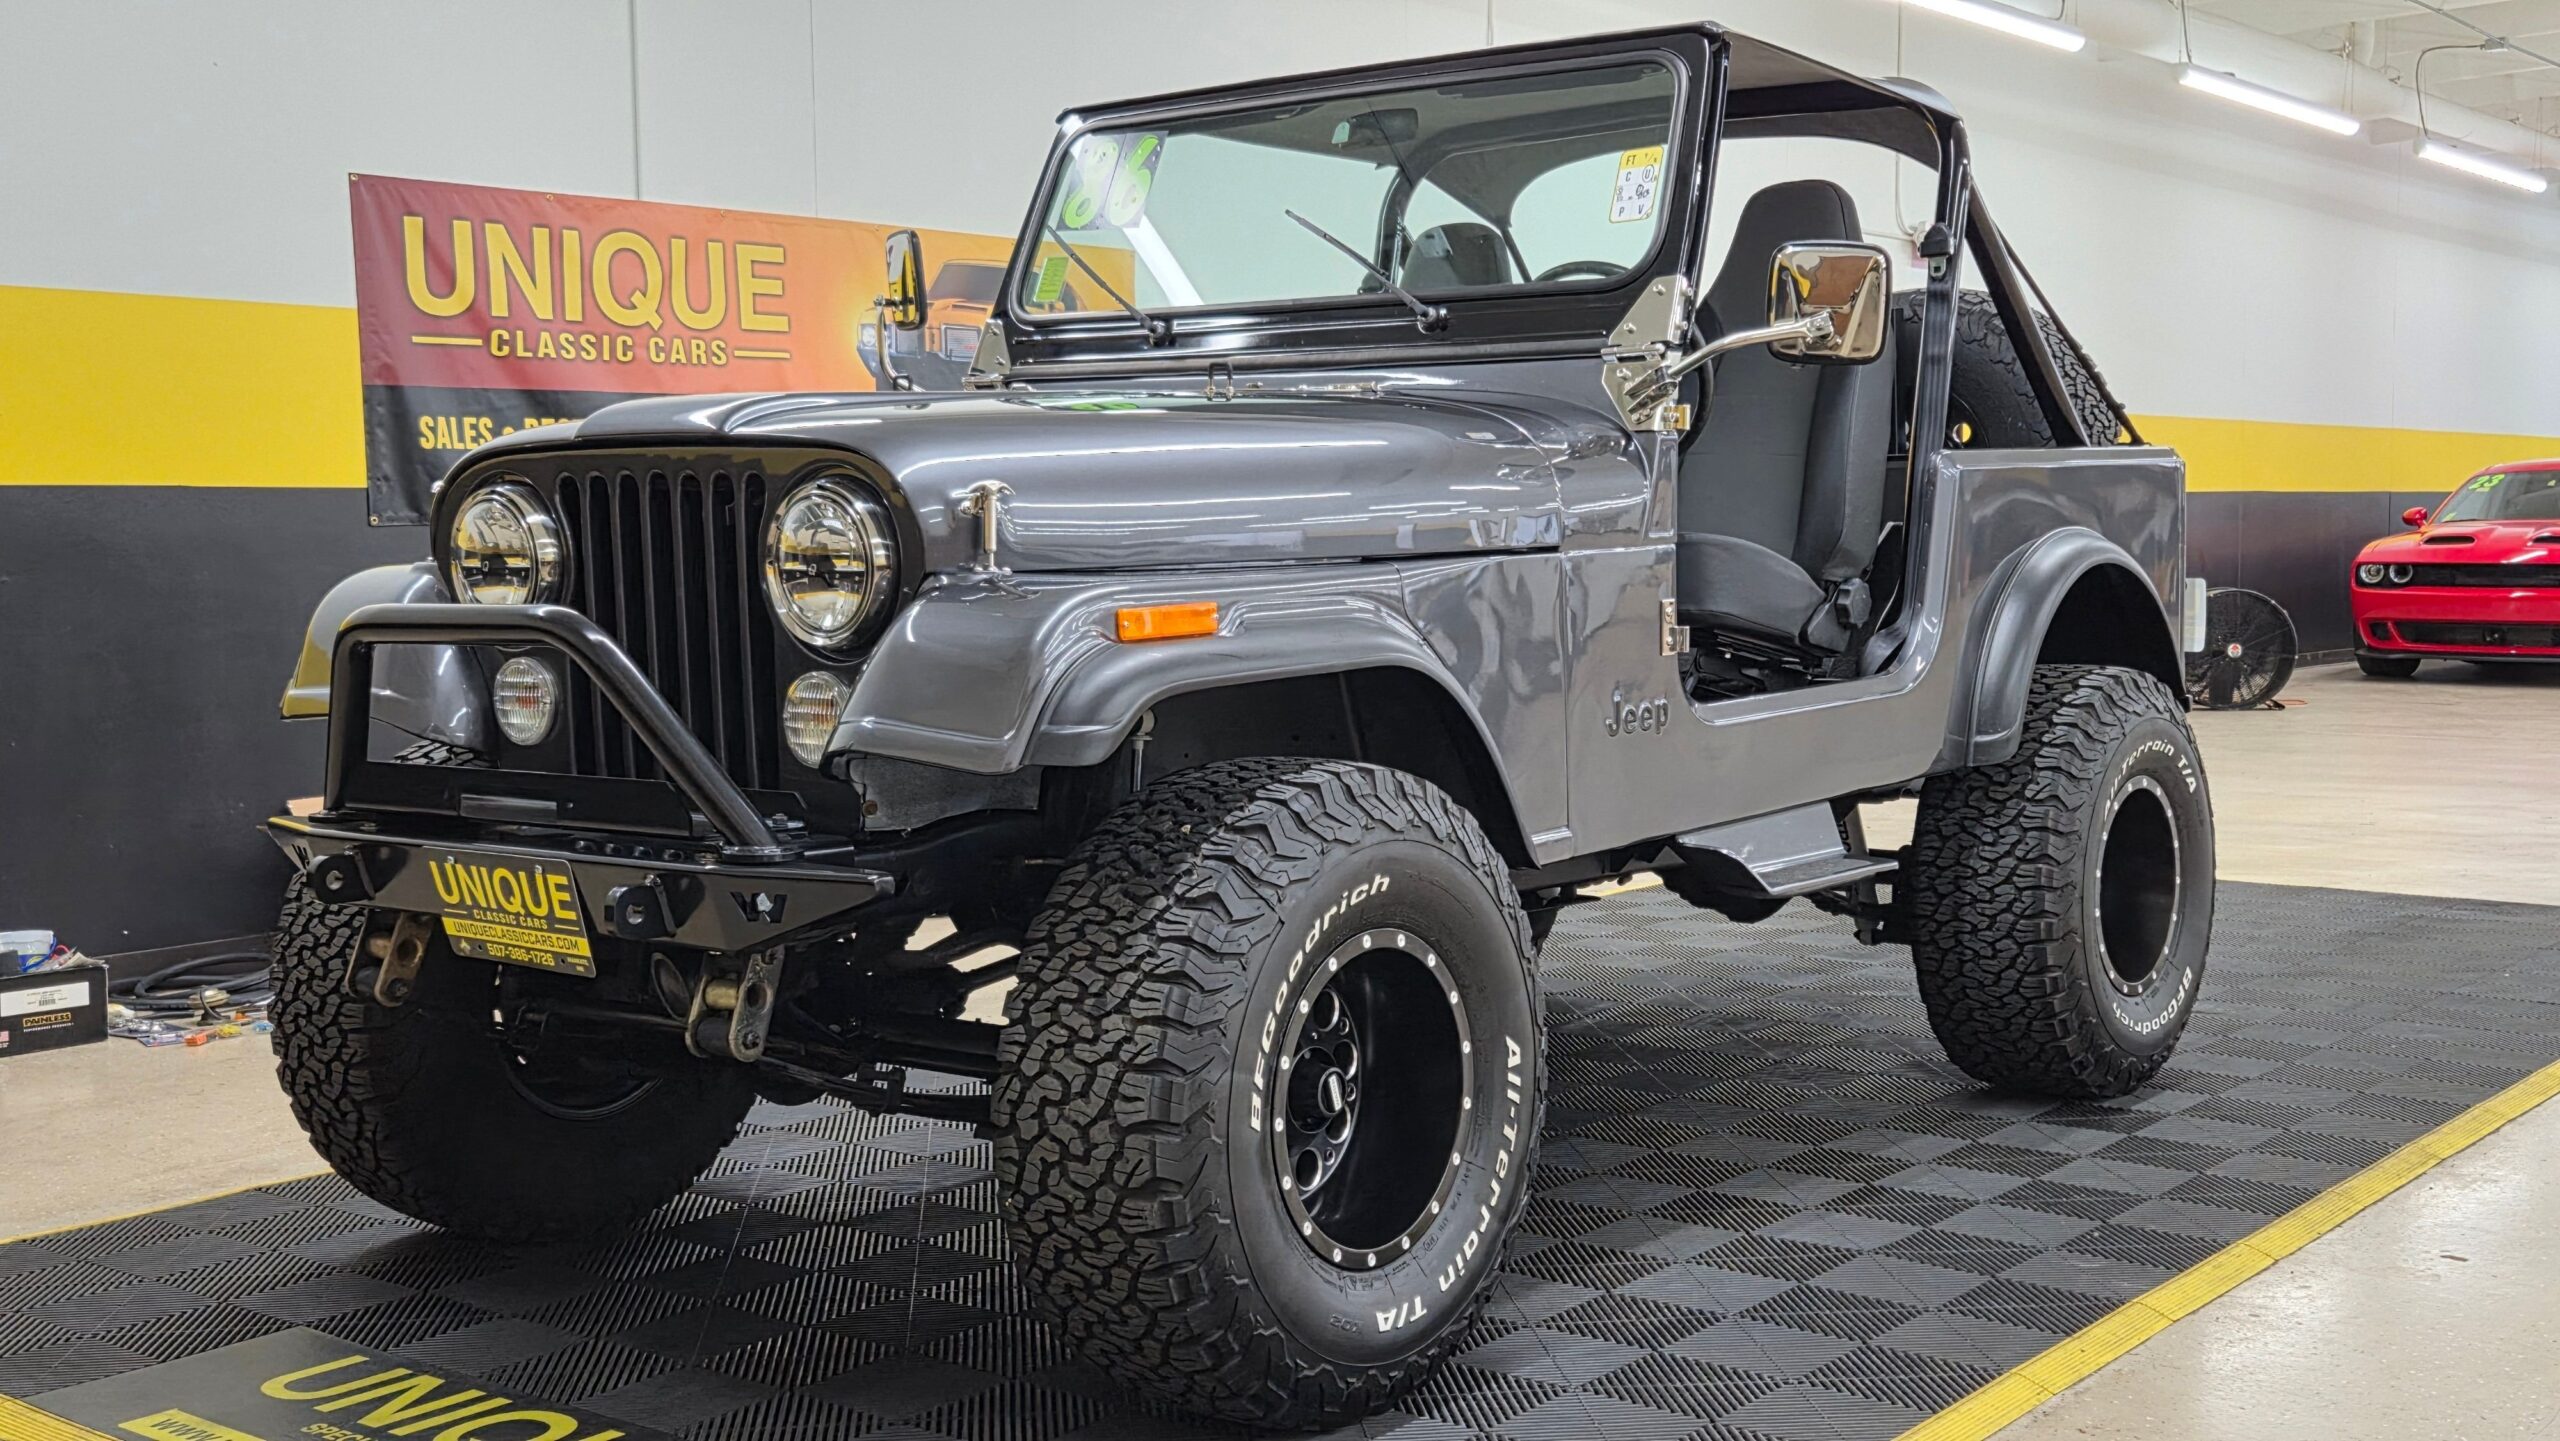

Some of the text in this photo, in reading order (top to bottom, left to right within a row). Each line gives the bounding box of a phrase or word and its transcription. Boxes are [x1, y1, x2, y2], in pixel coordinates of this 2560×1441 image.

[1063, 135, 1160, 229] 86
[402, 216, 790, 332] UNIQUE
[490, 329, 729, 367] CLASSIC CARS
[419, 415, 494, 450] SALES
[2468, 473, 2506, 491] 23
[1605, 689, 1669, 737] Jeep
[2177, 753, 2198, 794] T/A
[429, 861, 578, 920] UNIQUE
[453, 921, 581, 951] UNIQUECLASSICCARS.COM
[473, 909, 549, 930] CLASSIC CARS
[1250, 873, 1390, 1132] BFGoodrich
[2112, 965, 2193, 1035] BFGoodrich
[1438, 1034, 1523, 1292] All-Terrain
[1375, 1295, 1428, 1333] T/A
[260, 1355, 627, 1441] UNIQ
